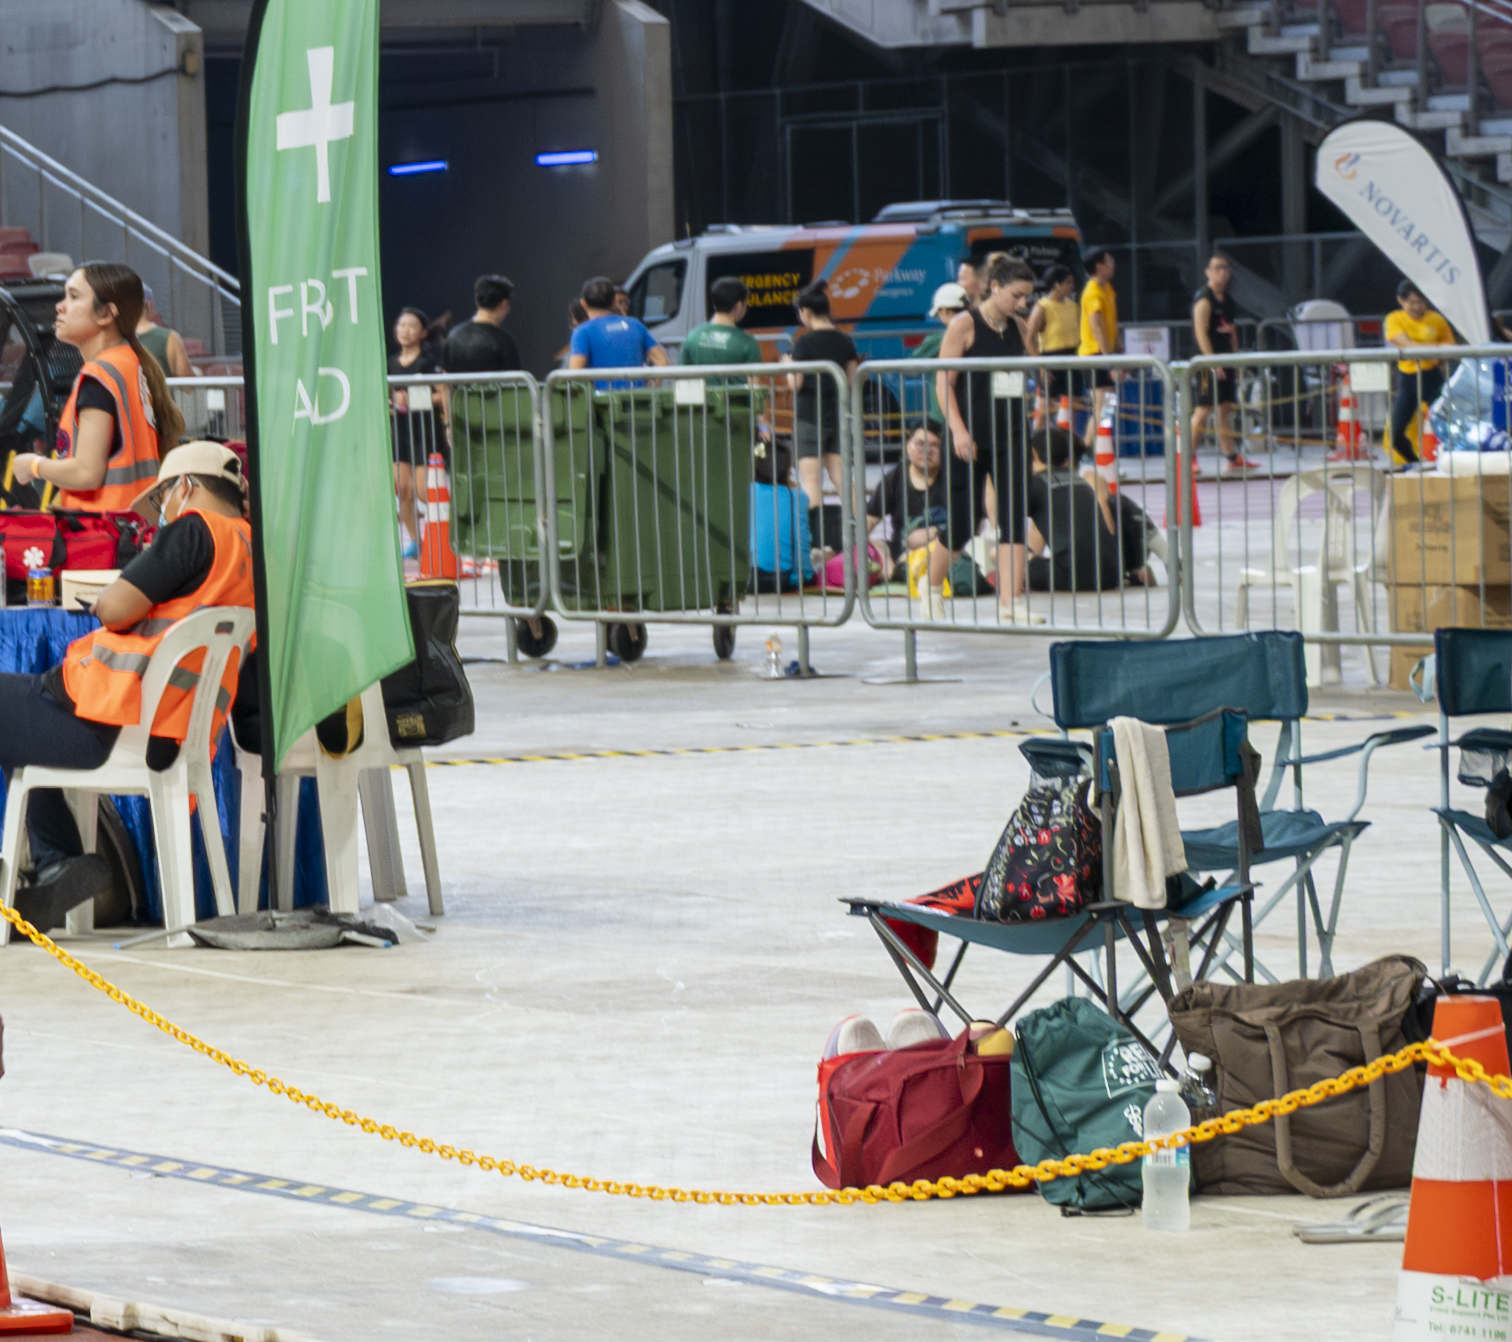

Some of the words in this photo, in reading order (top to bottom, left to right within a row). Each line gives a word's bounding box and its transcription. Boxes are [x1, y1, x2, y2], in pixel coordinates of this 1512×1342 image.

[1359, 181, 1461, 286] NOVARTIS
[874, 267, 928, 284] Parkway
[1431, 1285, 1510, 1313] S-LITE
